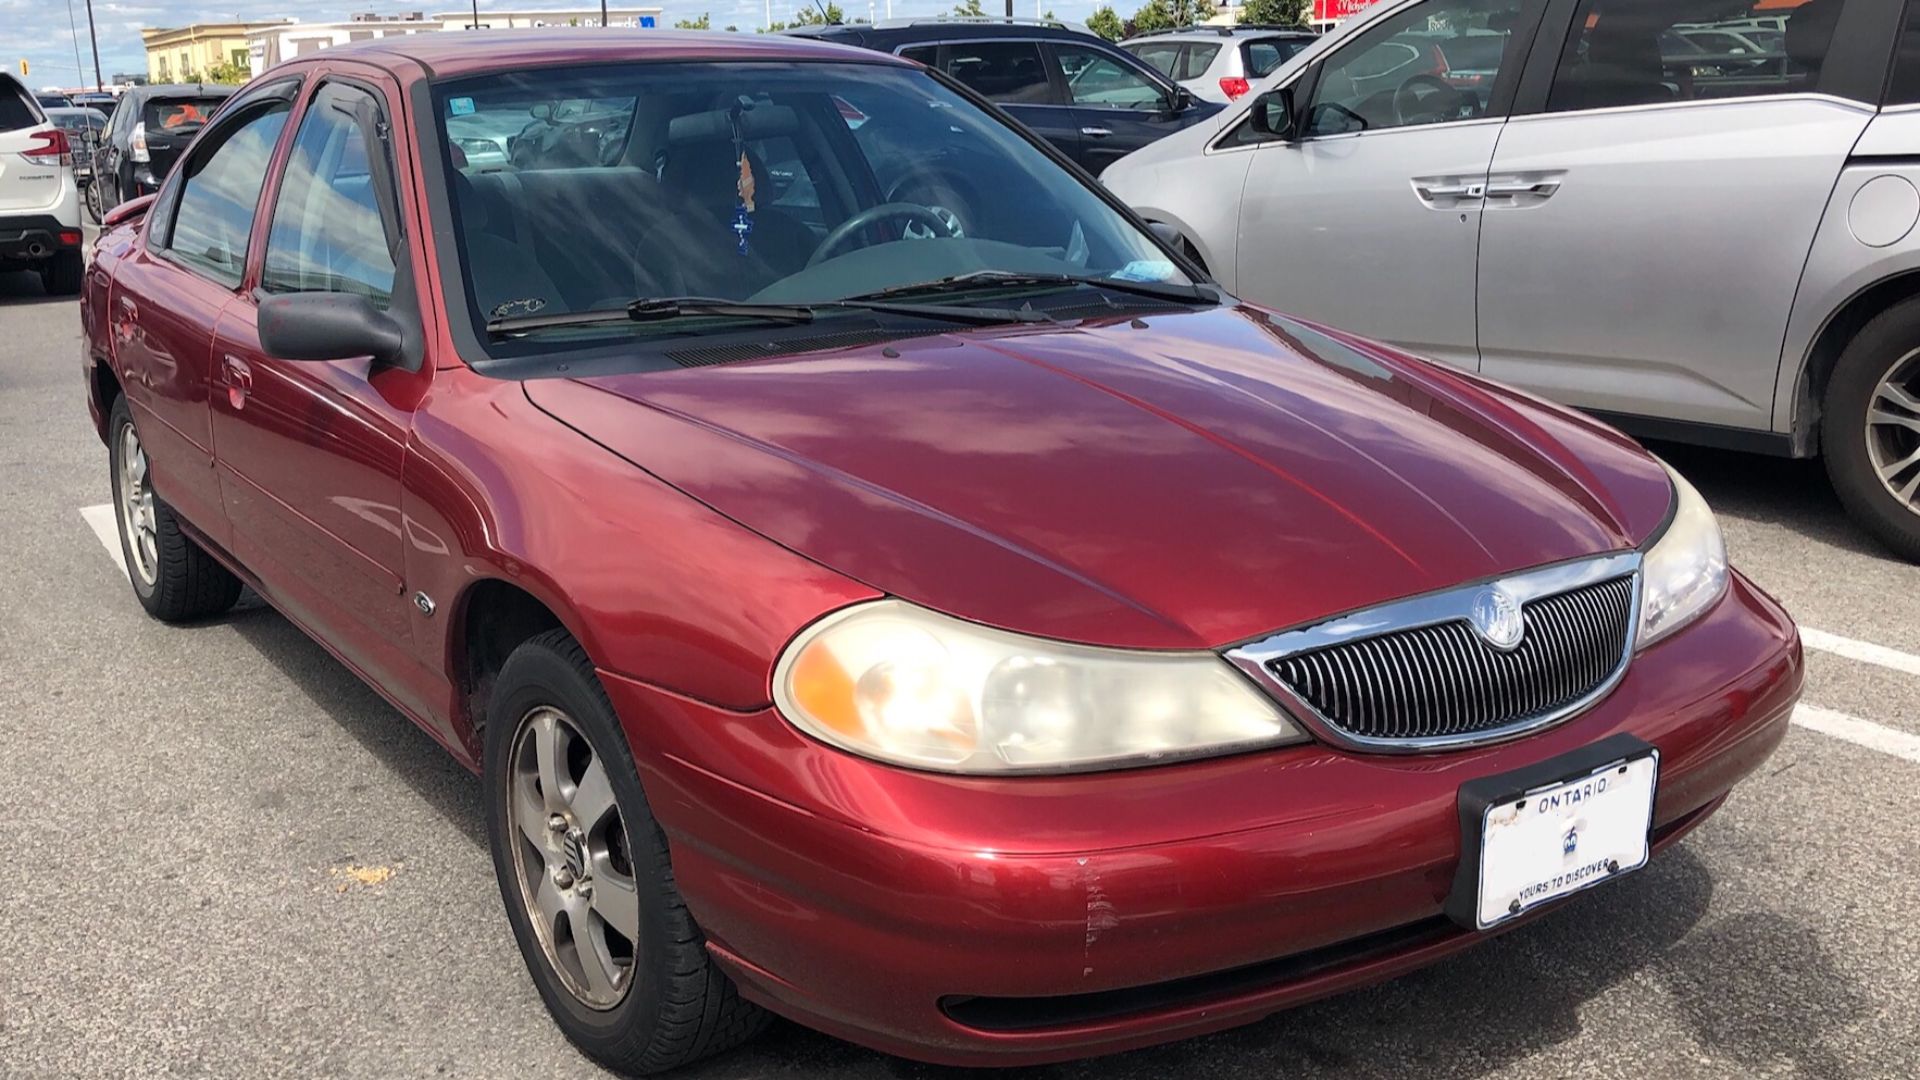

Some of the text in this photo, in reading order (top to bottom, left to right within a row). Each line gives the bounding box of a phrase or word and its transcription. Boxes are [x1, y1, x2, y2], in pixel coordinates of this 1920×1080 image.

[533, 16, 638, 29] Geore Ricards
[1538, 777, 1607, 815] ONTARIO
[1519, 857, 1609, 901] YOURS TO DISCOVER
